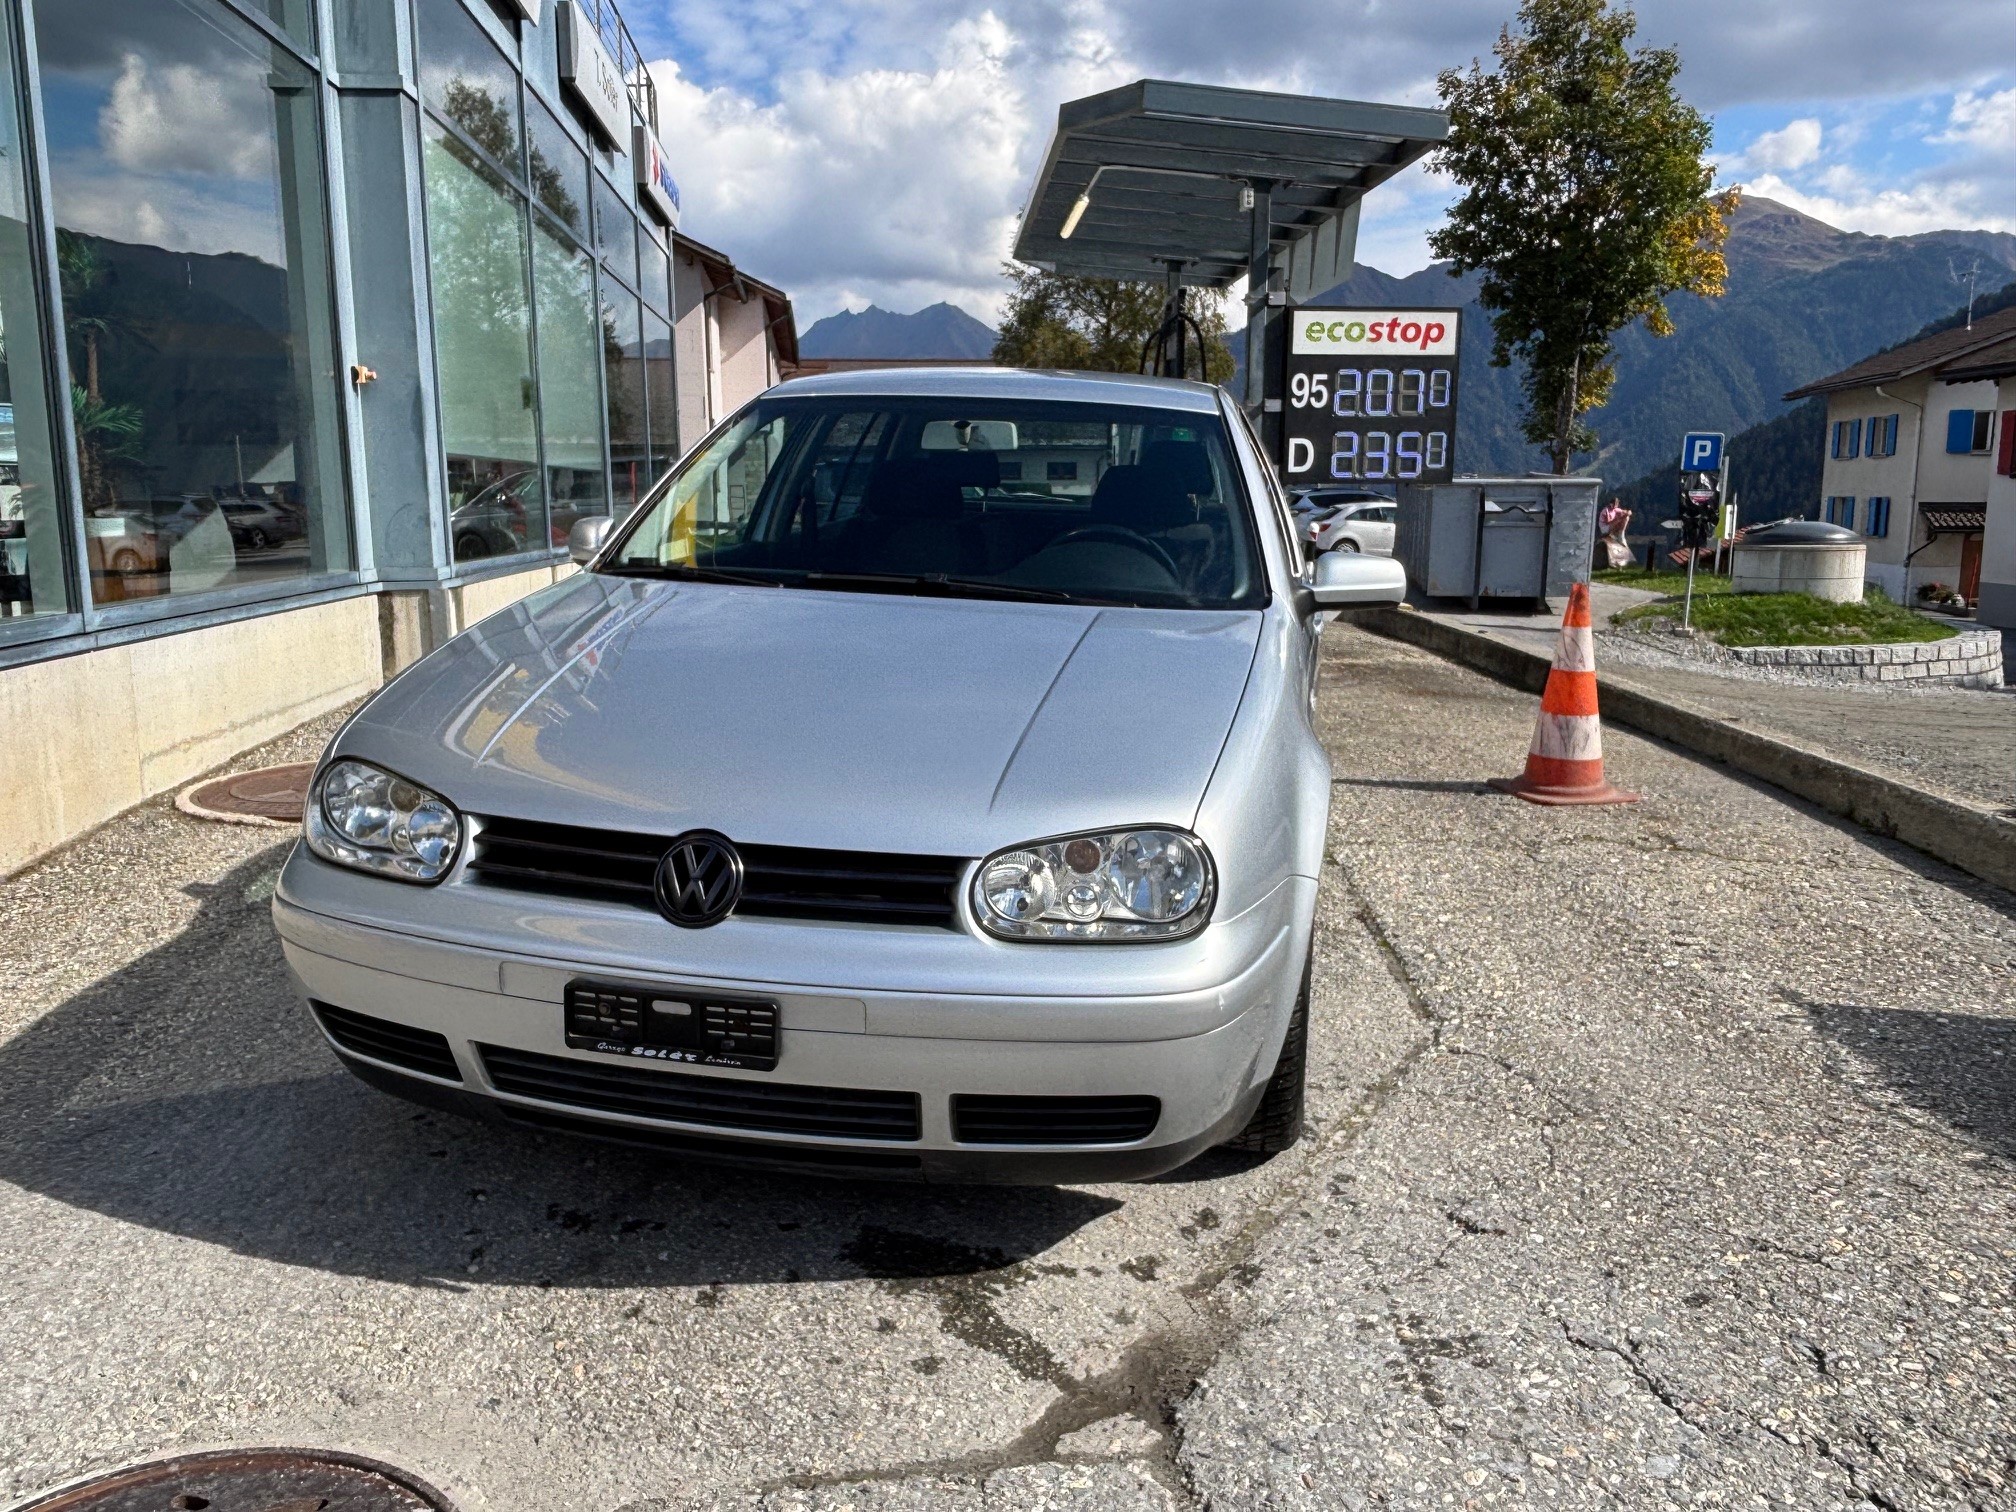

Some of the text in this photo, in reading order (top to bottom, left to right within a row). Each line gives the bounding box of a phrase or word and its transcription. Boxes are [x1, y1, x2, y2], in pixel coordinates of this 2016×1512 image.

[1305, 316, 1445, 350] ecostop
[1290, 372, 1329, 409] 95
[1287, 437, 1315, 473] D
[1693, 440, 1712, 466] P
